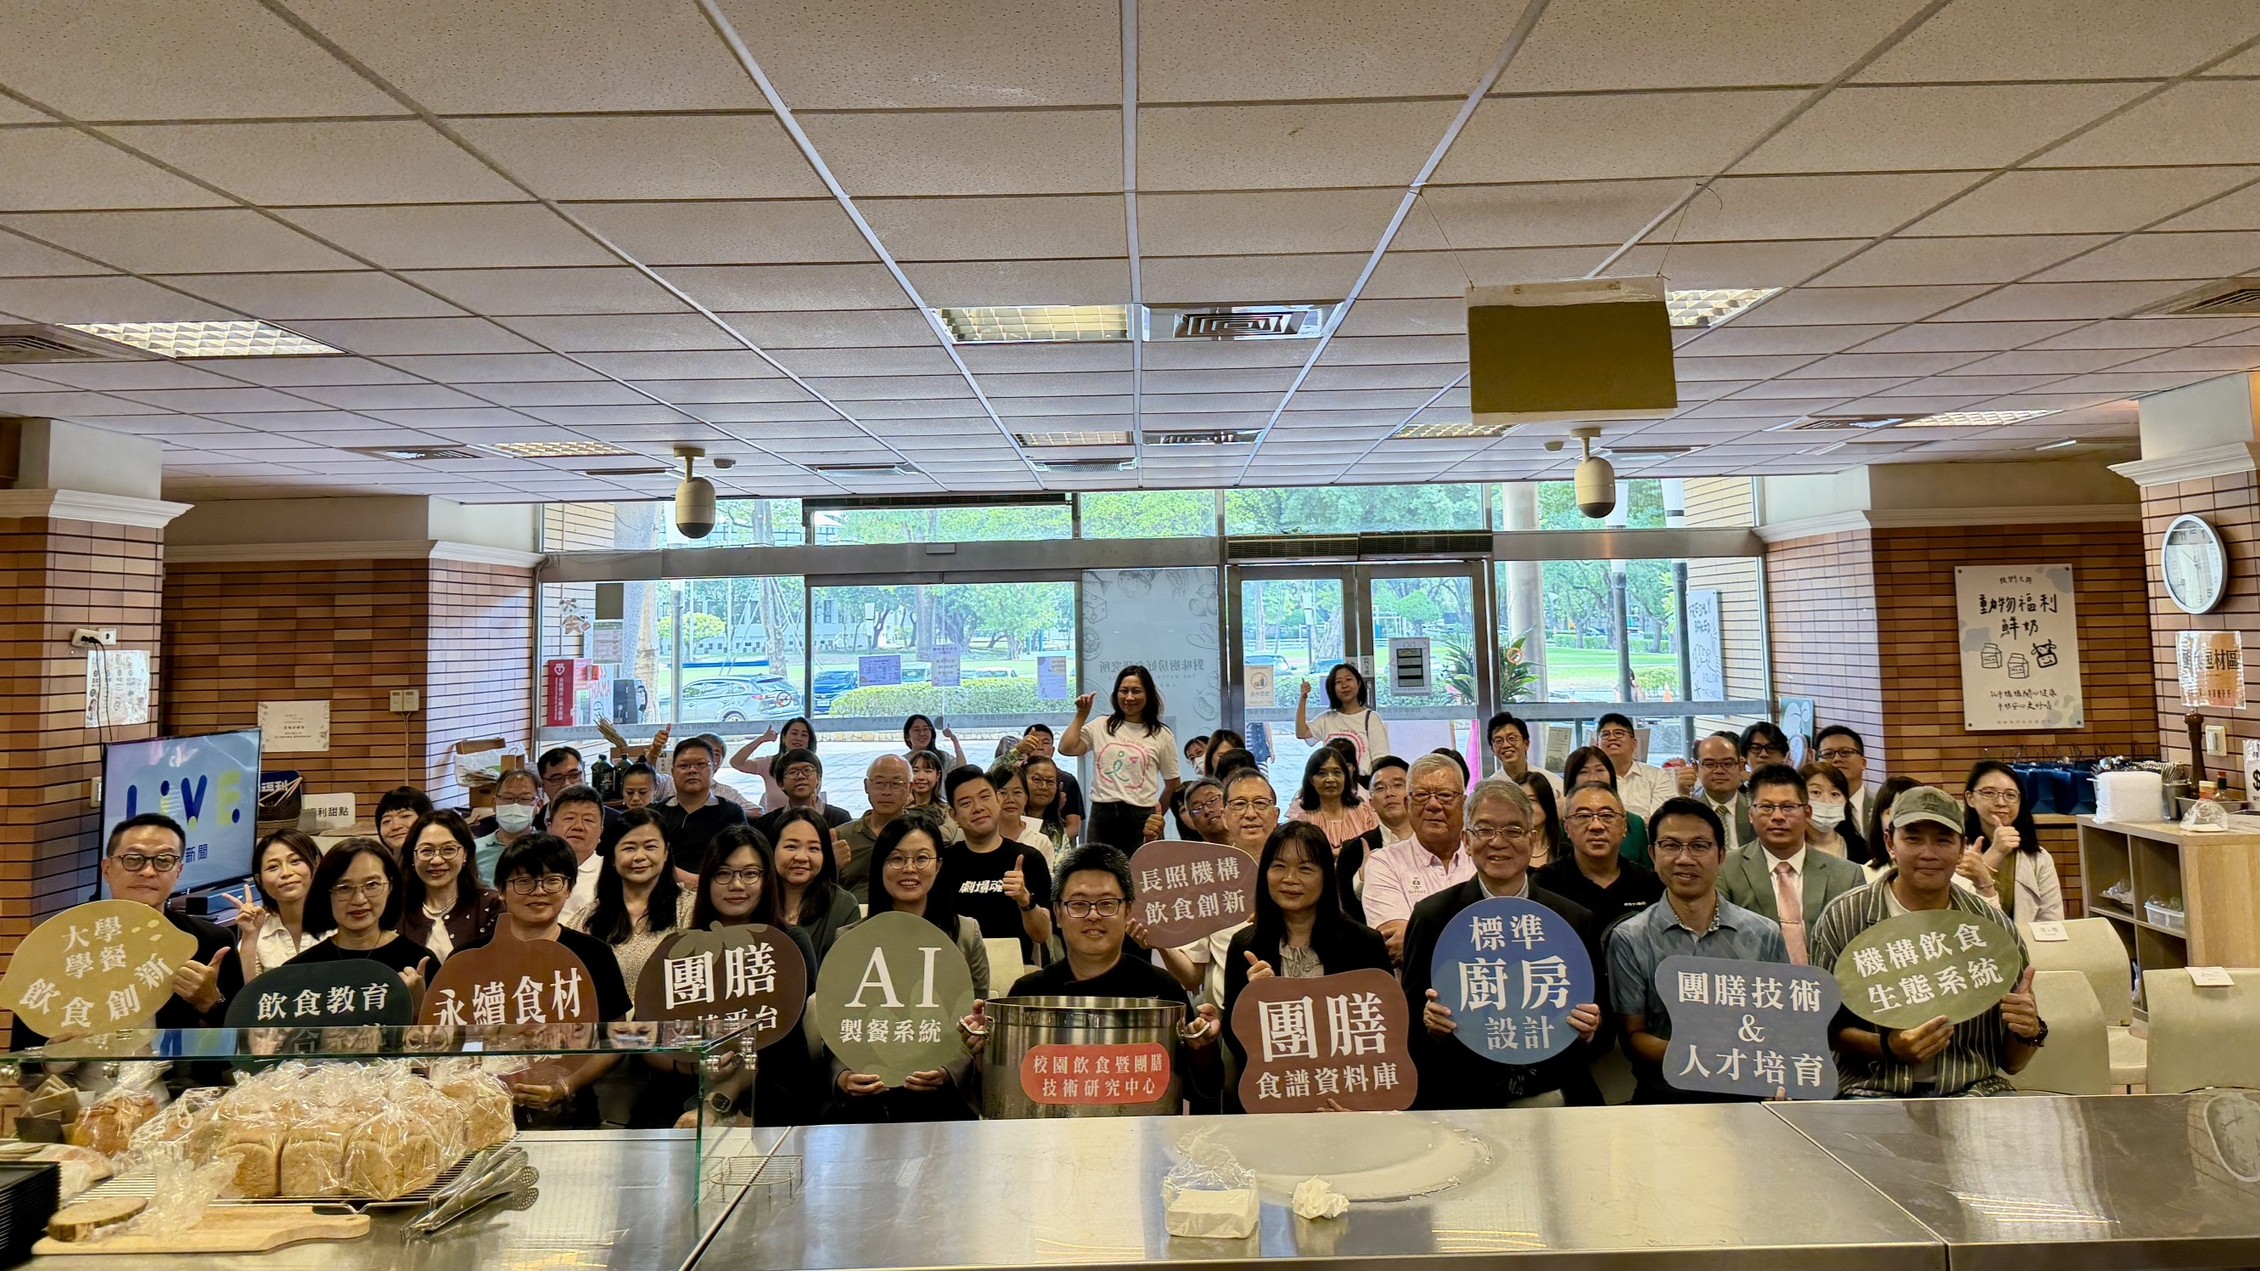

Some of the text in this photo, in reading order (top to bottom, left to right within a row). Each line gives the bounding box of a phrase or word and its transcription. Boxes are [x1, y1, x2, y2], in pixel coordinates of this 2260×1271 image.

[1979, 593, 2058, 615] 動物福利
[2000, 616, 2039, 641] 鮮奶
[1140, 856, 1240, 894] 長照機構
[1145, 889, 1246, 926] 飲食創新
[61, 915, 123, 953] 大學
[1469, 914, 1546, 951] 標準
[1852, 922, 1987, 979] 機構飲食
[65, 944, 127, 979] 學餐
[664, 942, 777, 1010] 團膳
[844, 946, 942, 1008] AI
[19, 952, 174, 1028] 飲食創新
[257, 982, 390, 1022] 飲食教育
[433, 967, 582, 1025] 永續食材
[1458, 954, 1571, 1012] 廚房
[1677, 970, 1822, 1012] 團膳技術
[1867, 957, 2004, 1014] 生態系統
[839, 1018, 942, 1044] 製餐系統
[1257, 991, 1387, 1063] 團膳
[1485, 1015, 1555, 1050] 設計
[1737, 1014, 1765, 1044] &
[1033, 1053, 1163, 1075] 校園飲食暨團膳
[1255, 1062, 1400, 1100] 食譜資料庫
[1678, 1044, 1824, 1088] 人才培育
[1042, 1077, 1155, 1098] 技術研究中心
